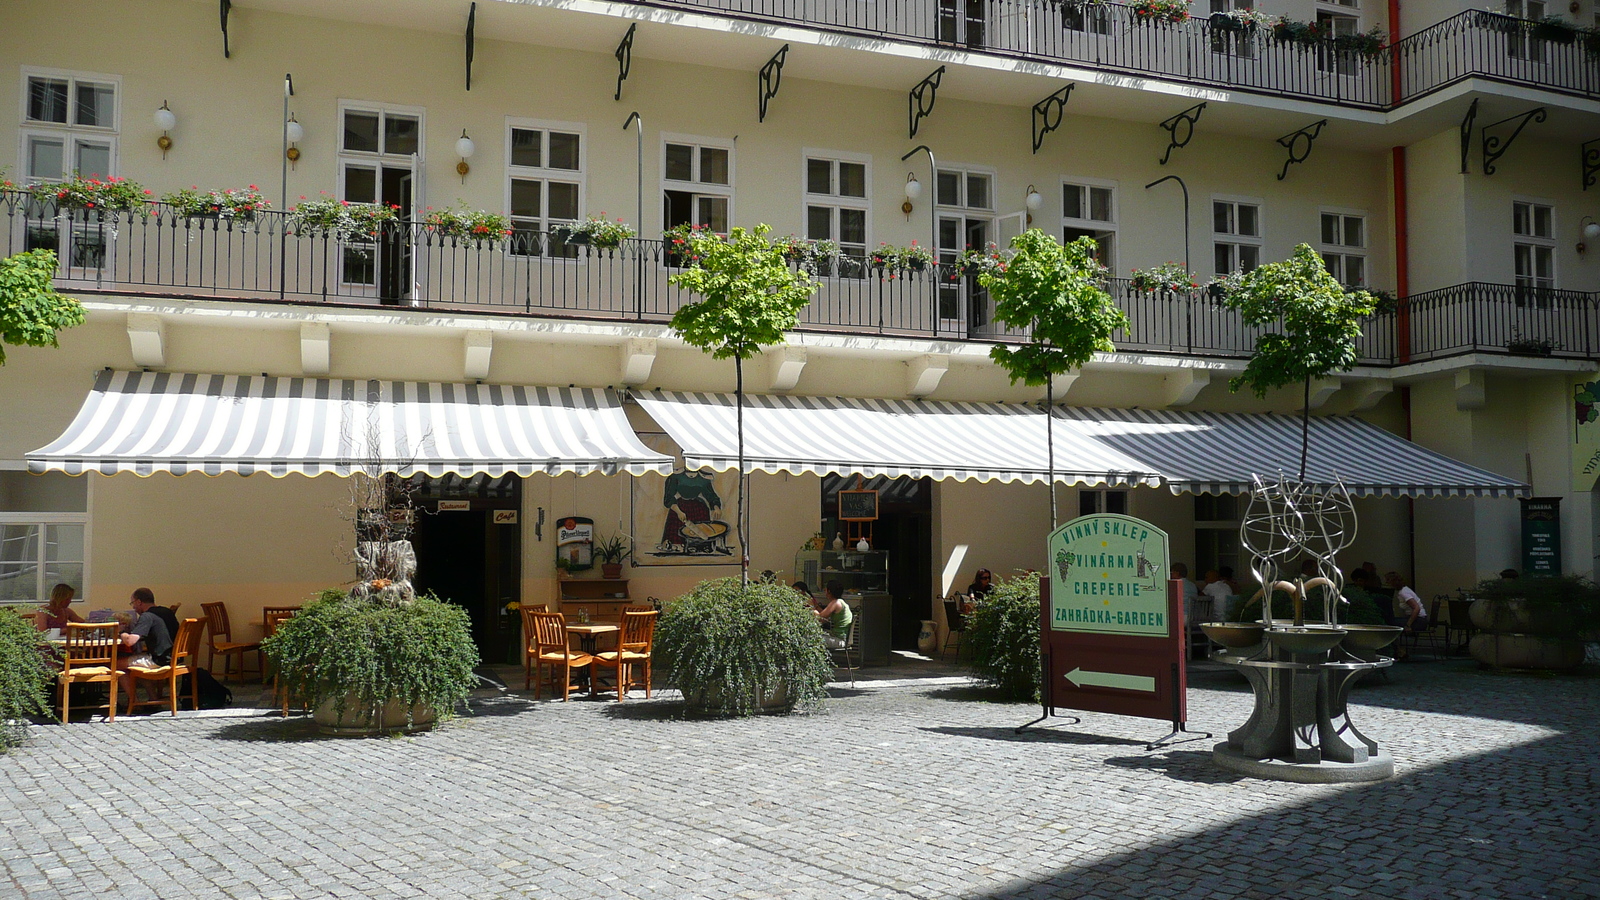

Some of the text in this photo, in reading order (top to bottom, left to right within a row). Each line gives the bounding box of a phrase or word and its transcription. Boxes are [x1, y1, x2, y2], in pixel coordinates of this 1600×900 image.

[439, 502, 468, 510] Restaurant
[1062, 519, 1148, 545] VINNÝ SKLEP
[1076, 553, 1134, 569] VINÁRNA
[1074, 581, 1140, 597] CREPERIE
[1055, 607, 1163, 627] ZAHRÁDKA-GARDEN
